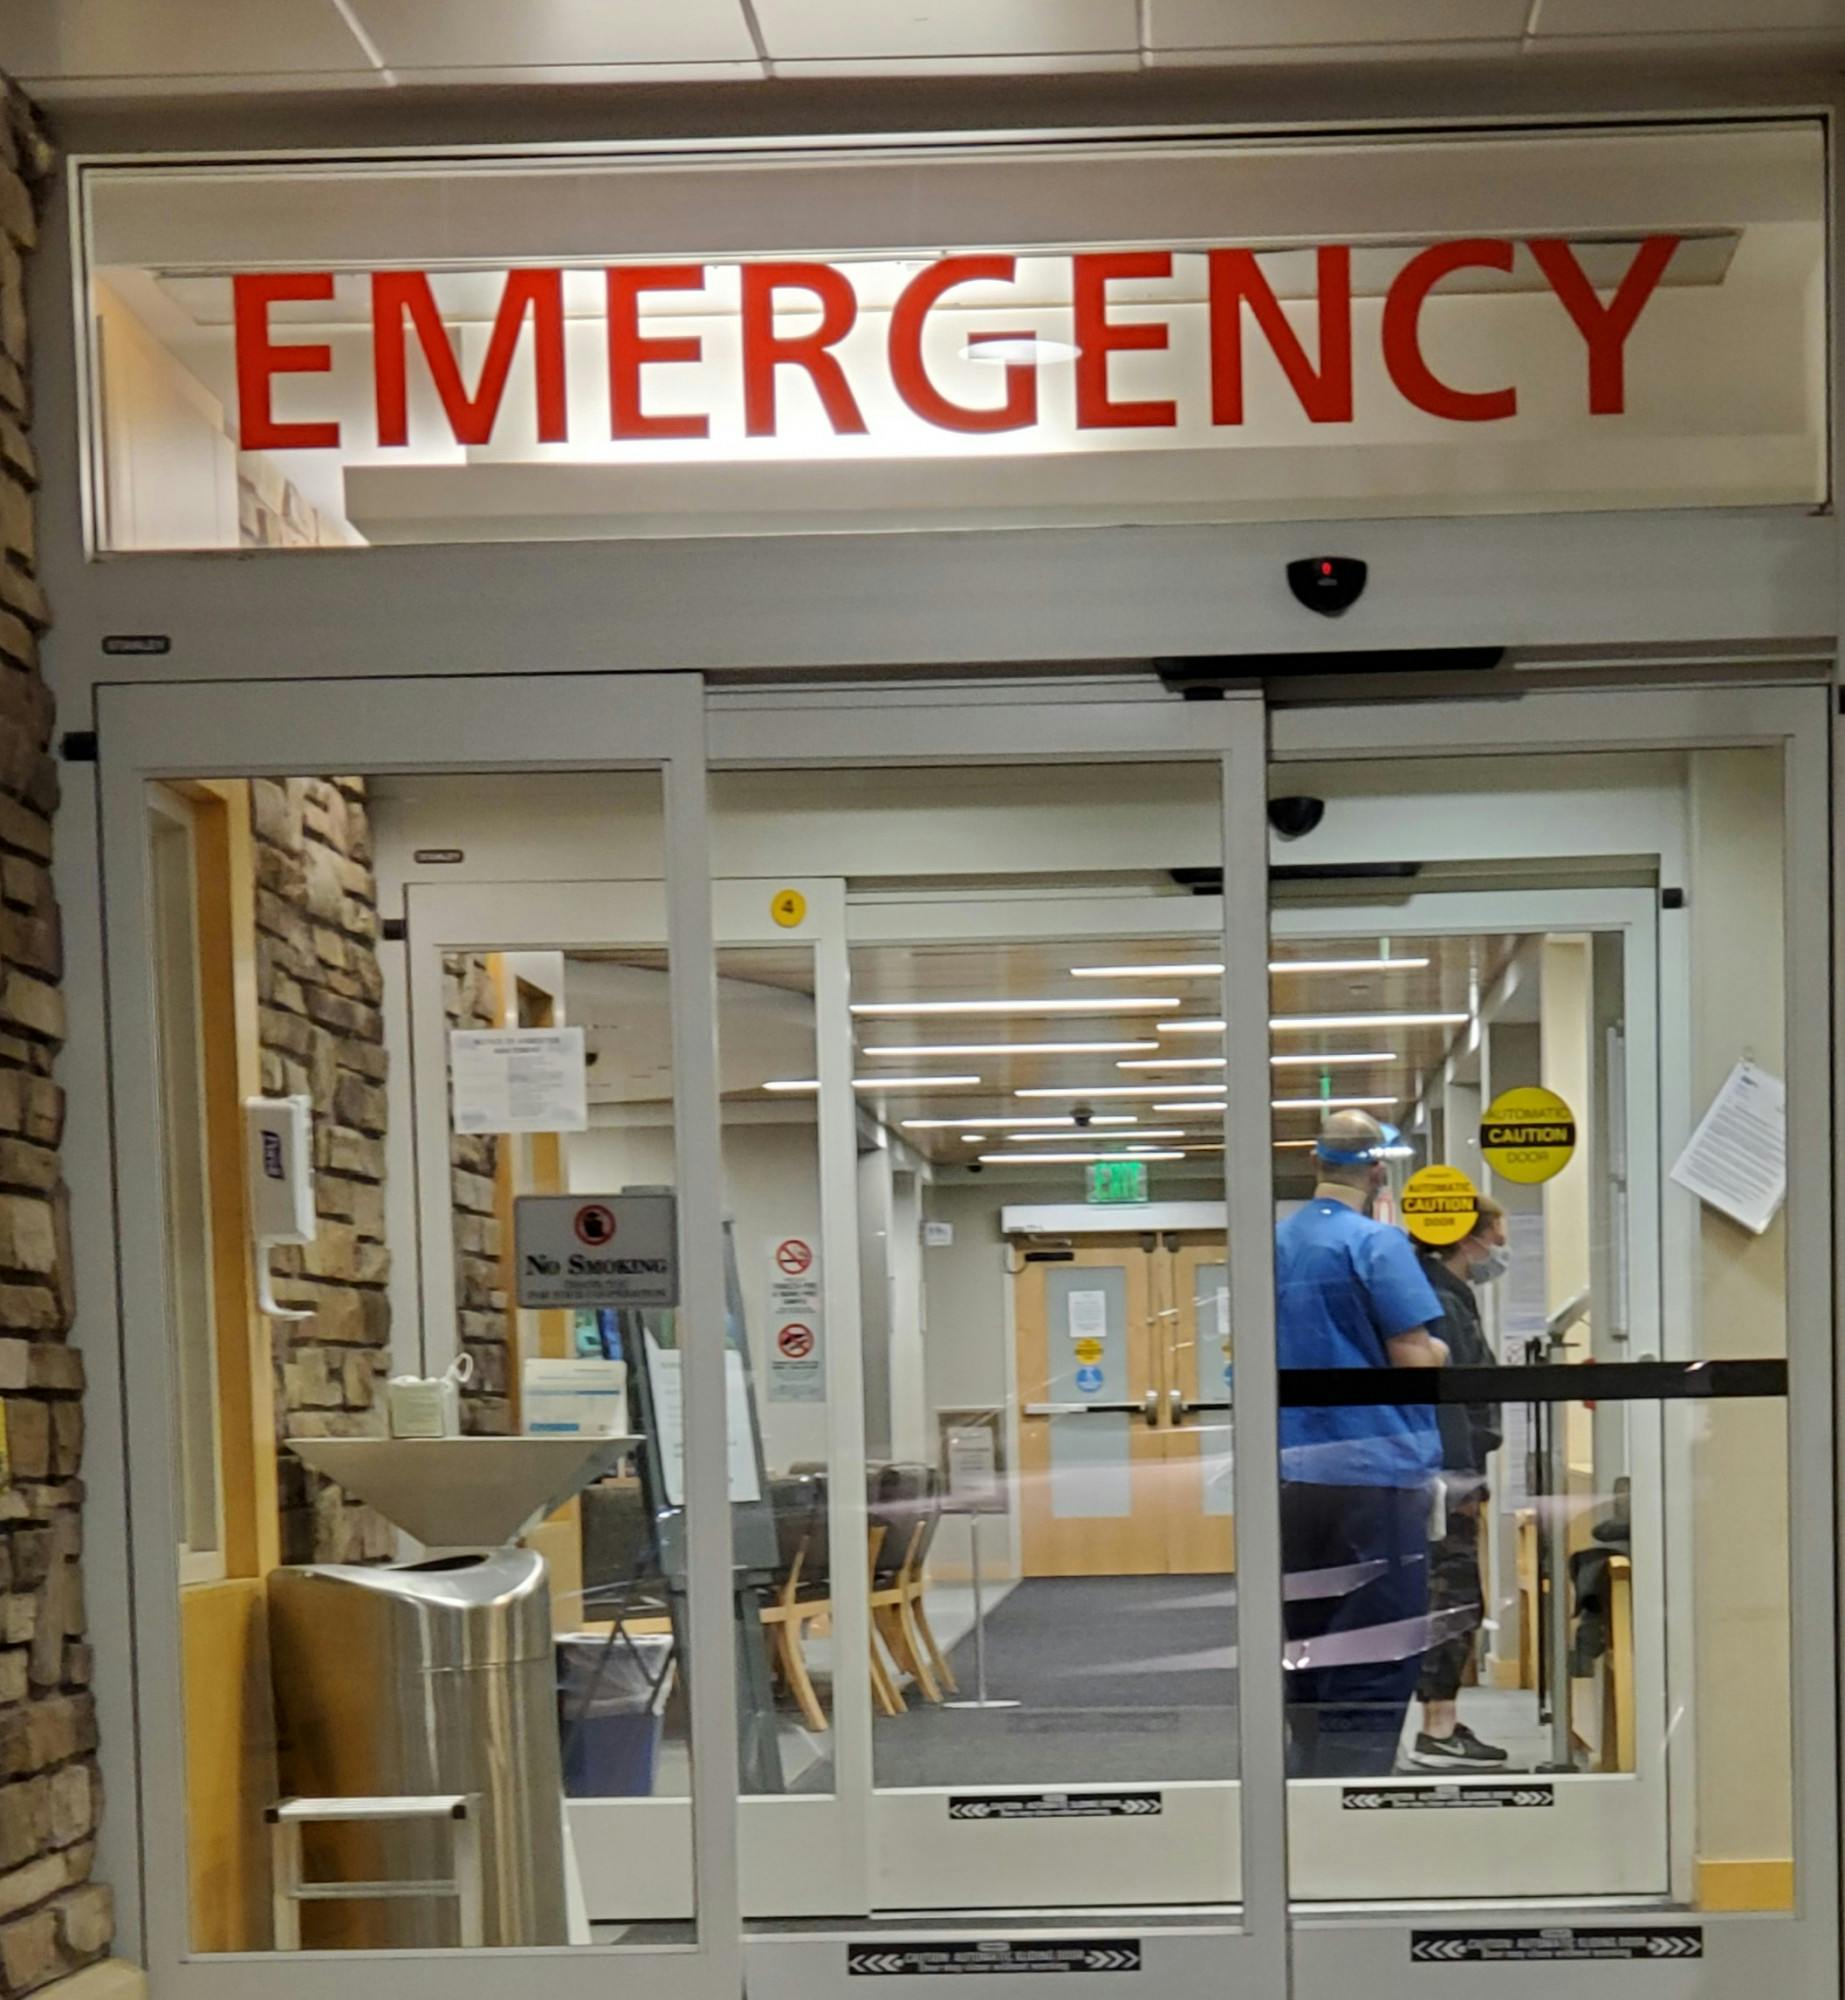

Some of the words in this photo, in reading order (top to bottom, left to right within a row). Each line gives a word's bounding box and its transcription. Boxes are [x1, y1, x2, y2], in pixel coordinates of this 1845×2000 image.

[233, 236, 1679, 451] EMERGENCY
[1488, 1107, 1570, 1121] AUTOMATIC
[1488, 1127, 1568, 1143] CAUTION
[1506, 1151, 1549, 1164] DOOR
[1403, 1198, 1474, 1212] CAUTION
